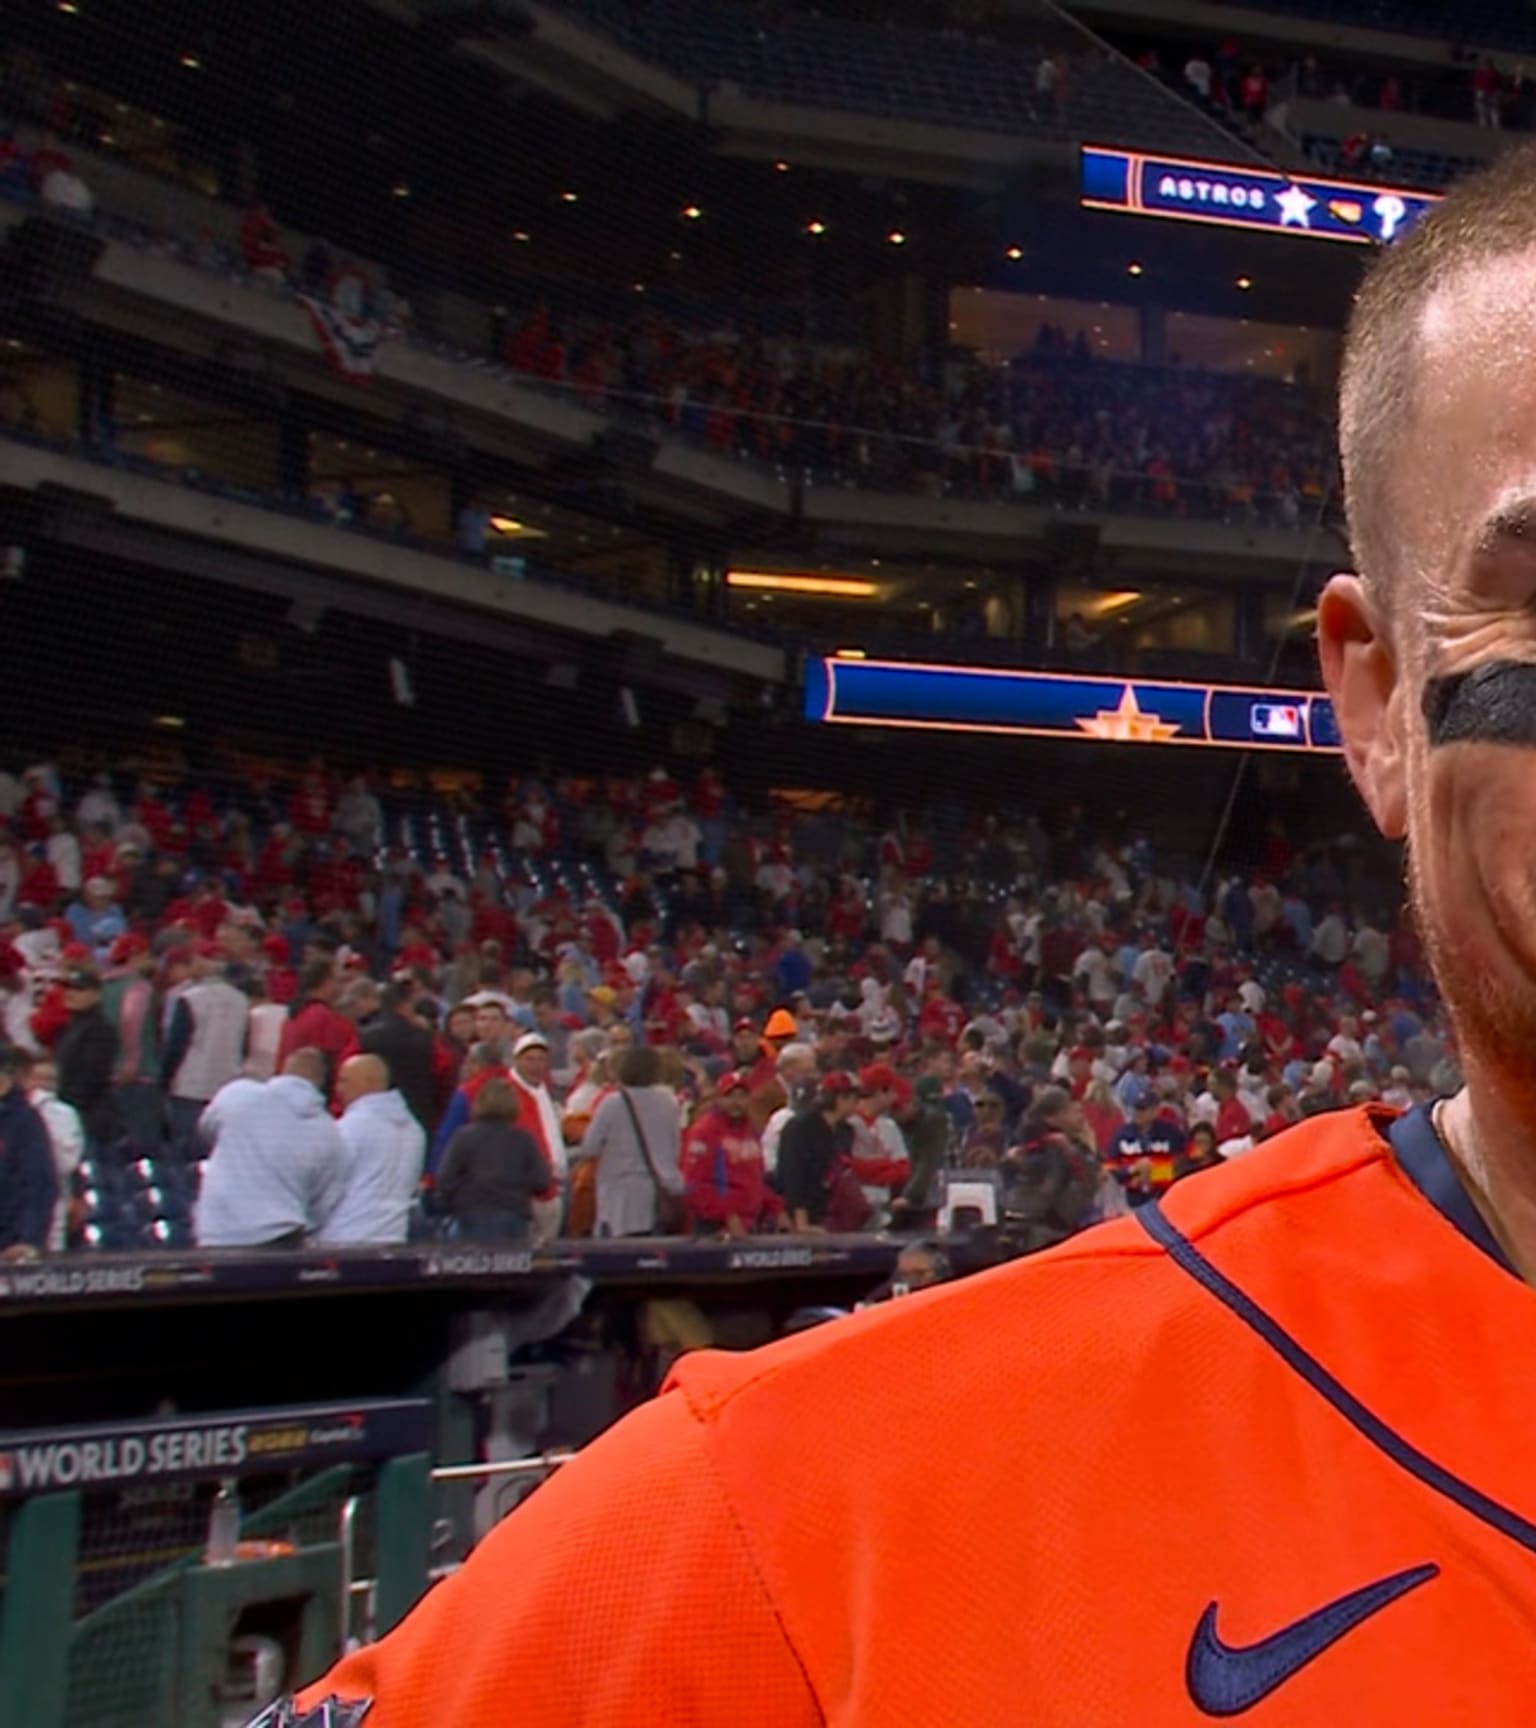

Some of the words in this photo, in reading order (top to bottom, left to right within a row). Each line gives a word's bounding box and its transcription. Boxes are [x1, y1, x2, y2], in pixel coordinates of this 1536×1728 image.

[1159, 176, 1265, 209] ASTROS
[14, 1271, 85, 1295] WORLD
[86, 1266, 146, 1292] SERIES
[17, 1437, 144, 1487] WORLD
[145, 1425, 247, 1473] SERIES
